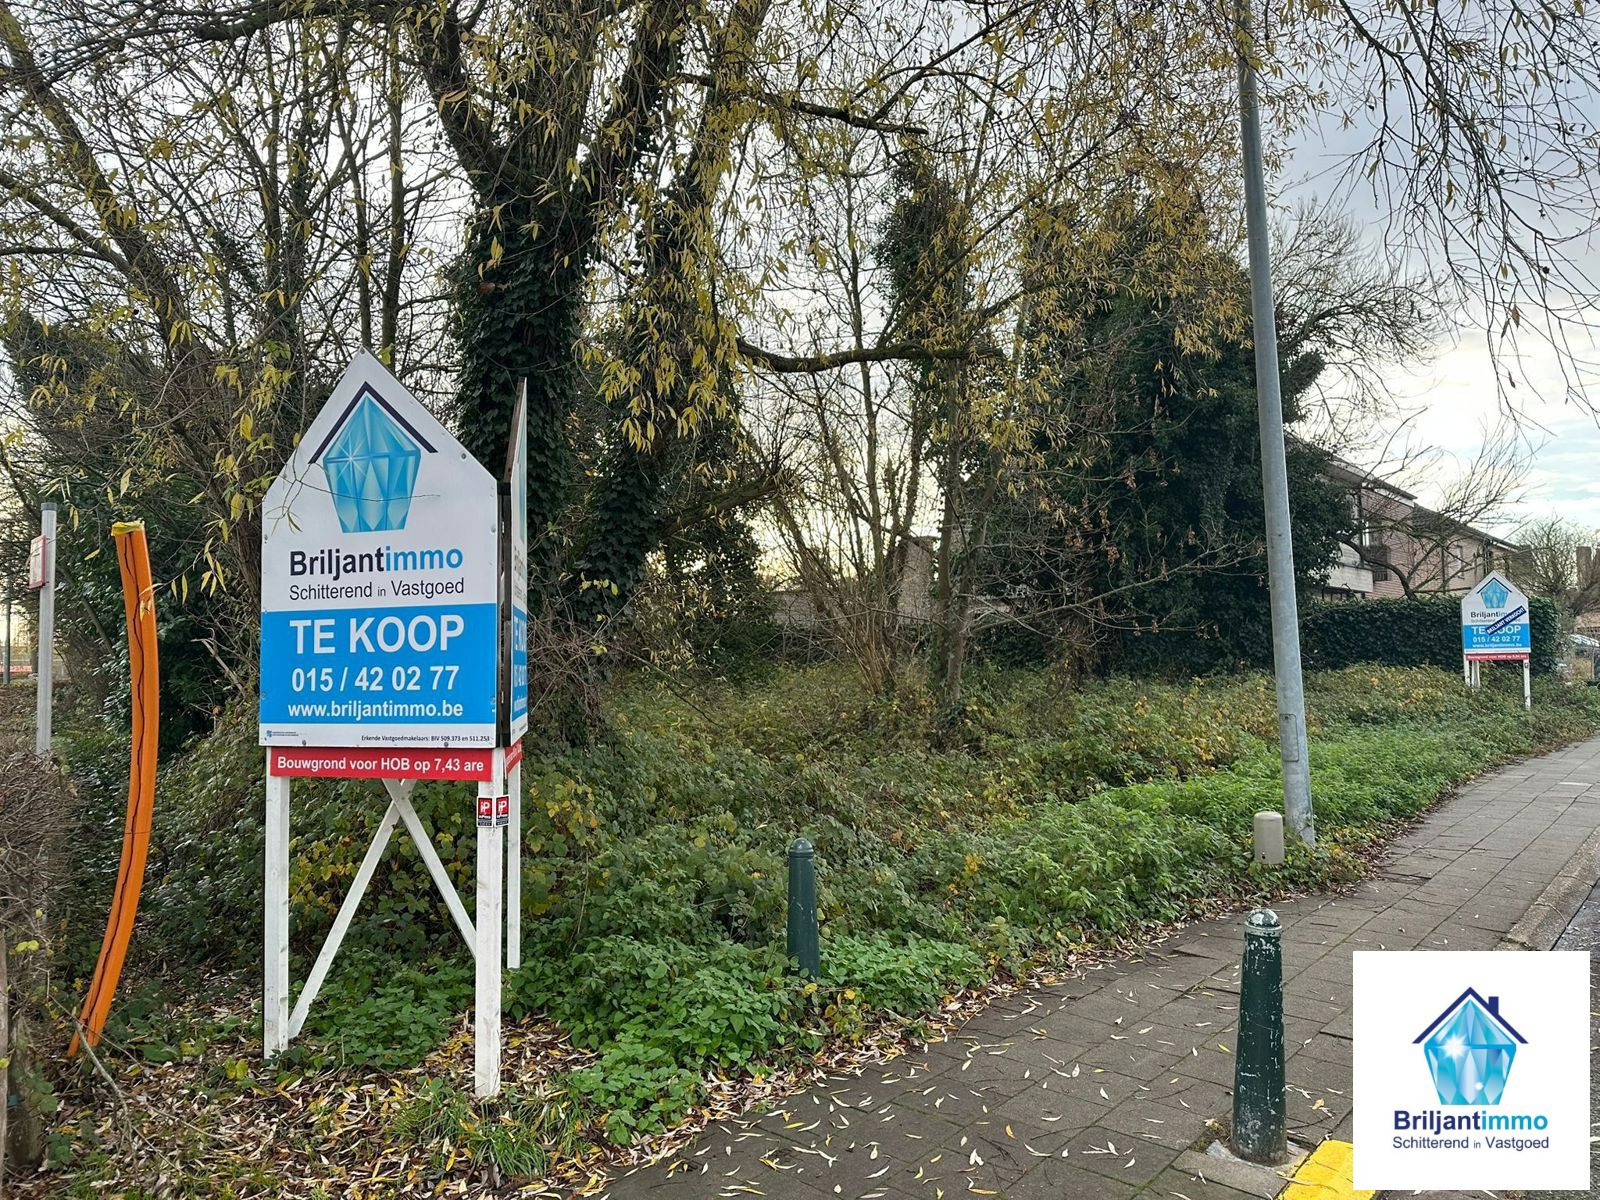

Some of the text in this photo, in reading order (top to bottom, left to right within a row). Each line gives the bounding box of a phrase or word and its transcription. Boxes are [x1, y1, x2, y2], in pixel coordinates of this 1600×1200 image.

[290, 546, 463, 581] Briljantimmo
[290, 577, 464, 601] Schitterend in Vastgoed
[289, 615, 464, 654] TE KOOP
[1472, 625, 1521, 635] TE OOP
[291, 665, 460, 692] 015 / 42 02 77
[288, 700, 463, 721] www.briljantimmo.be
[382, 735, 430, 743] Vastgoedmakelaars:
[277, 756, 484, 773] Bouwgrond voor HOB op 7,43 are
